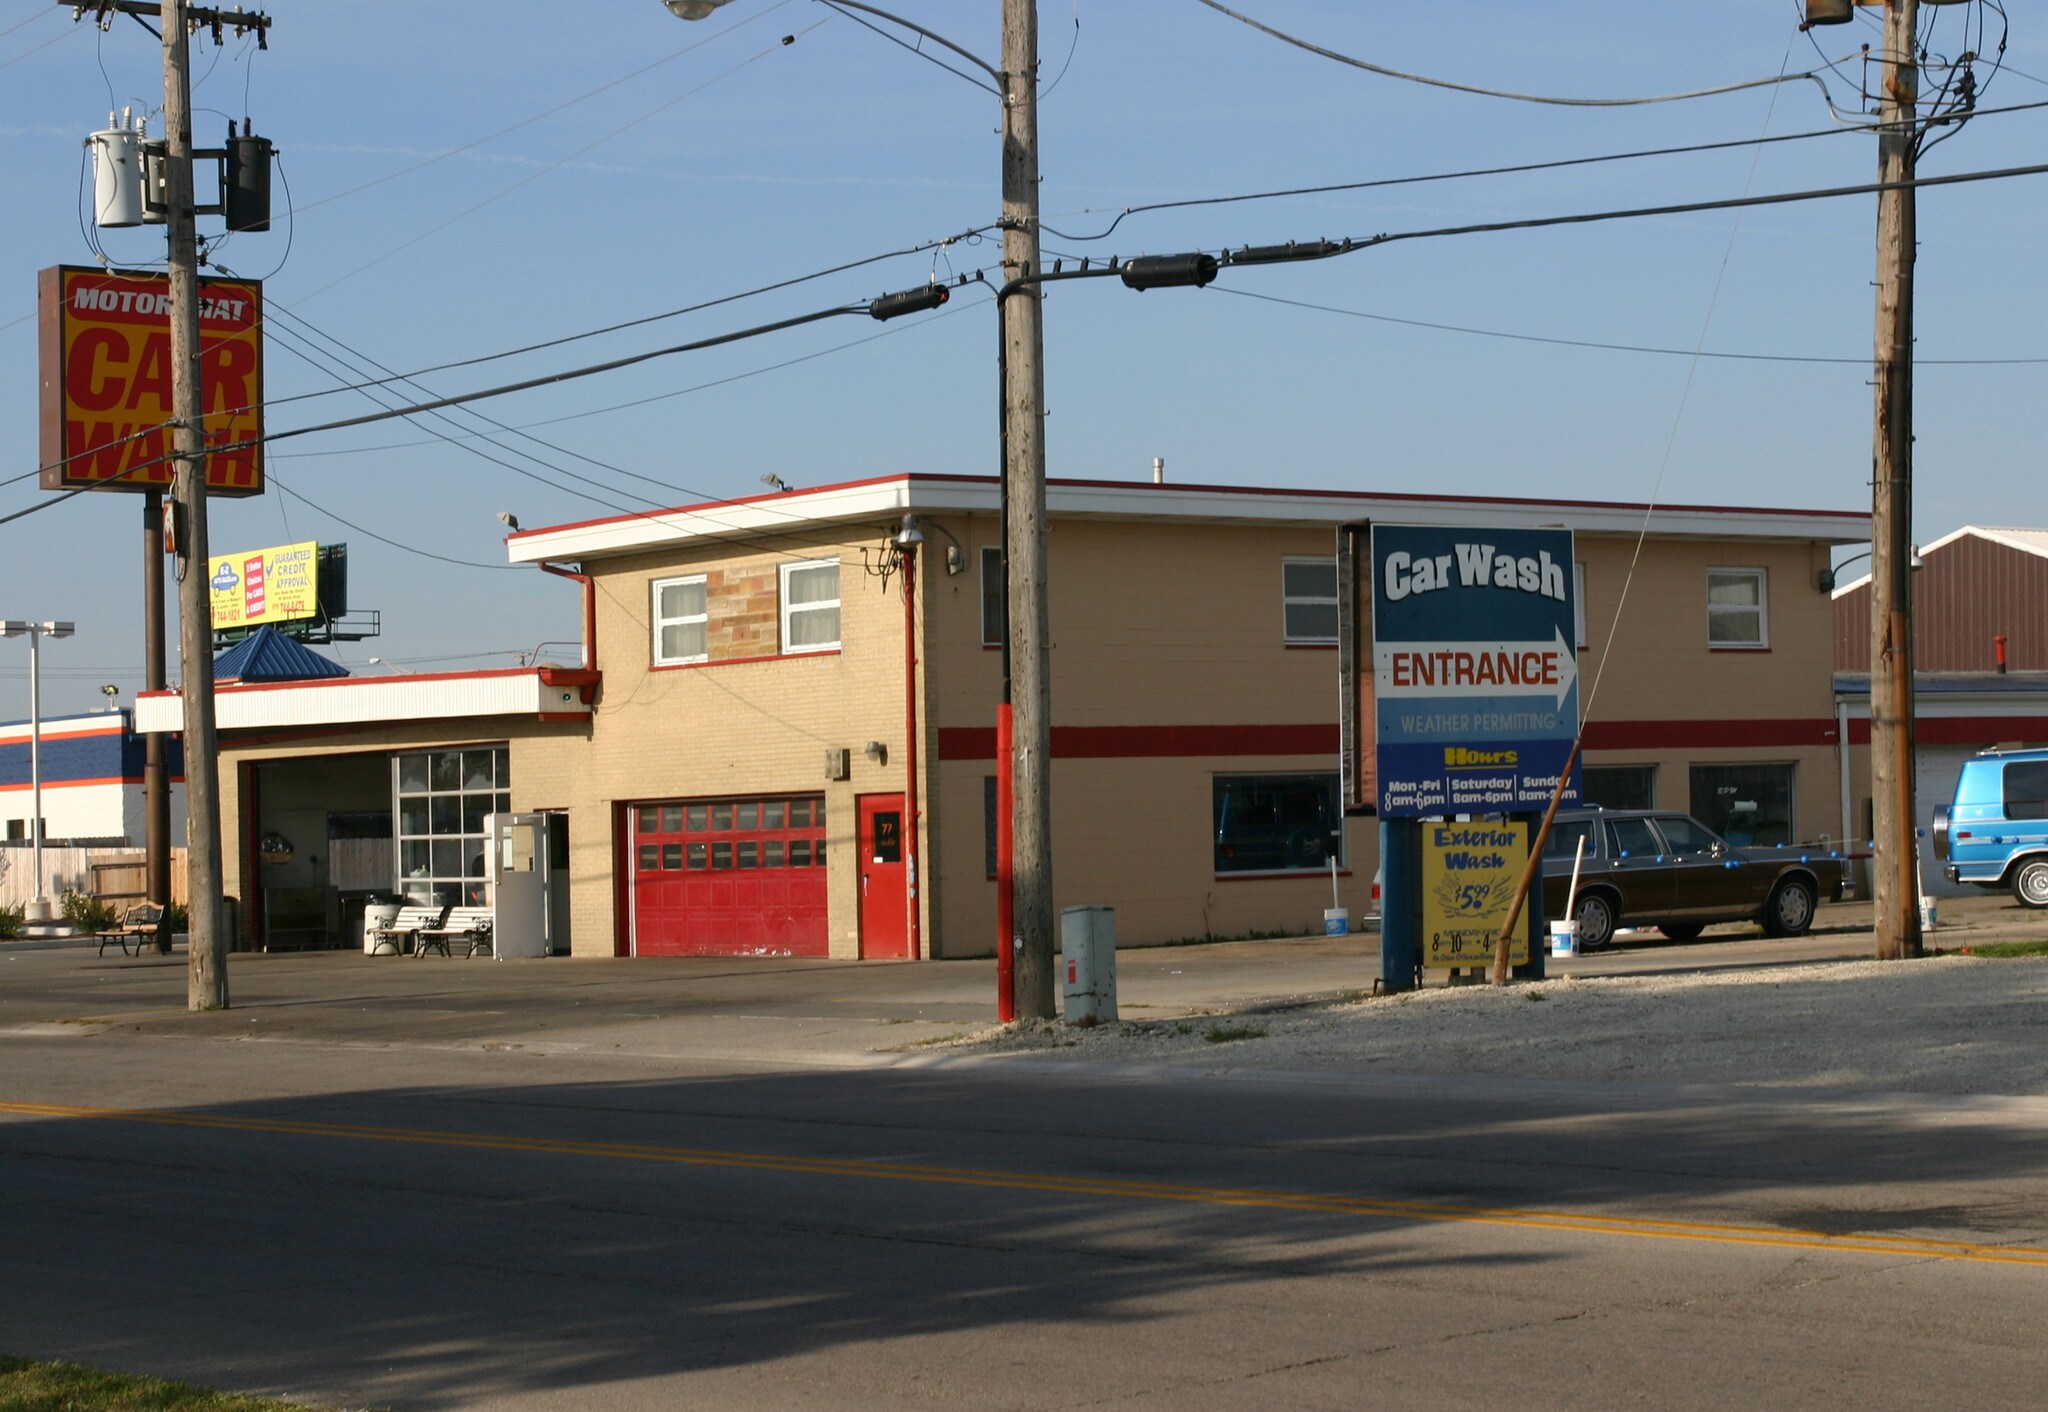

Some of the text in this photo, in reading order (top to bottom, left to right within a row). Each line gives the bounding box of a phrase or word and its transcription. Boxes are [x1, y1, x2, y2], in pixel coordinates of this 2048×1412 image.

[66, 327, 255, 416] CAR
[66, 420, 258, 485] WAH
[274, 549, 311, 564] GUARANTEED
[277, 563, 306, 576] CREDIT
[1384, 543, 1566, 602] Car Wash
[276, 576, 308, 589] APPROVAL
[1393, 652, 1558, 686] ENTRANCE
[1401, 713, 1557, 733] WEATHER PERMITTING
[1444, 747, 1518, 765] Hours
[1452, 777, 1513, 791] Saturday
[1453, 792, 1513, 804] 8am-6pm
[1518, 790, 1577, 801] 8am-2m
[1434, 828, 1516, 847] Exterior
[1445, 852, 1505, 870] Wash
